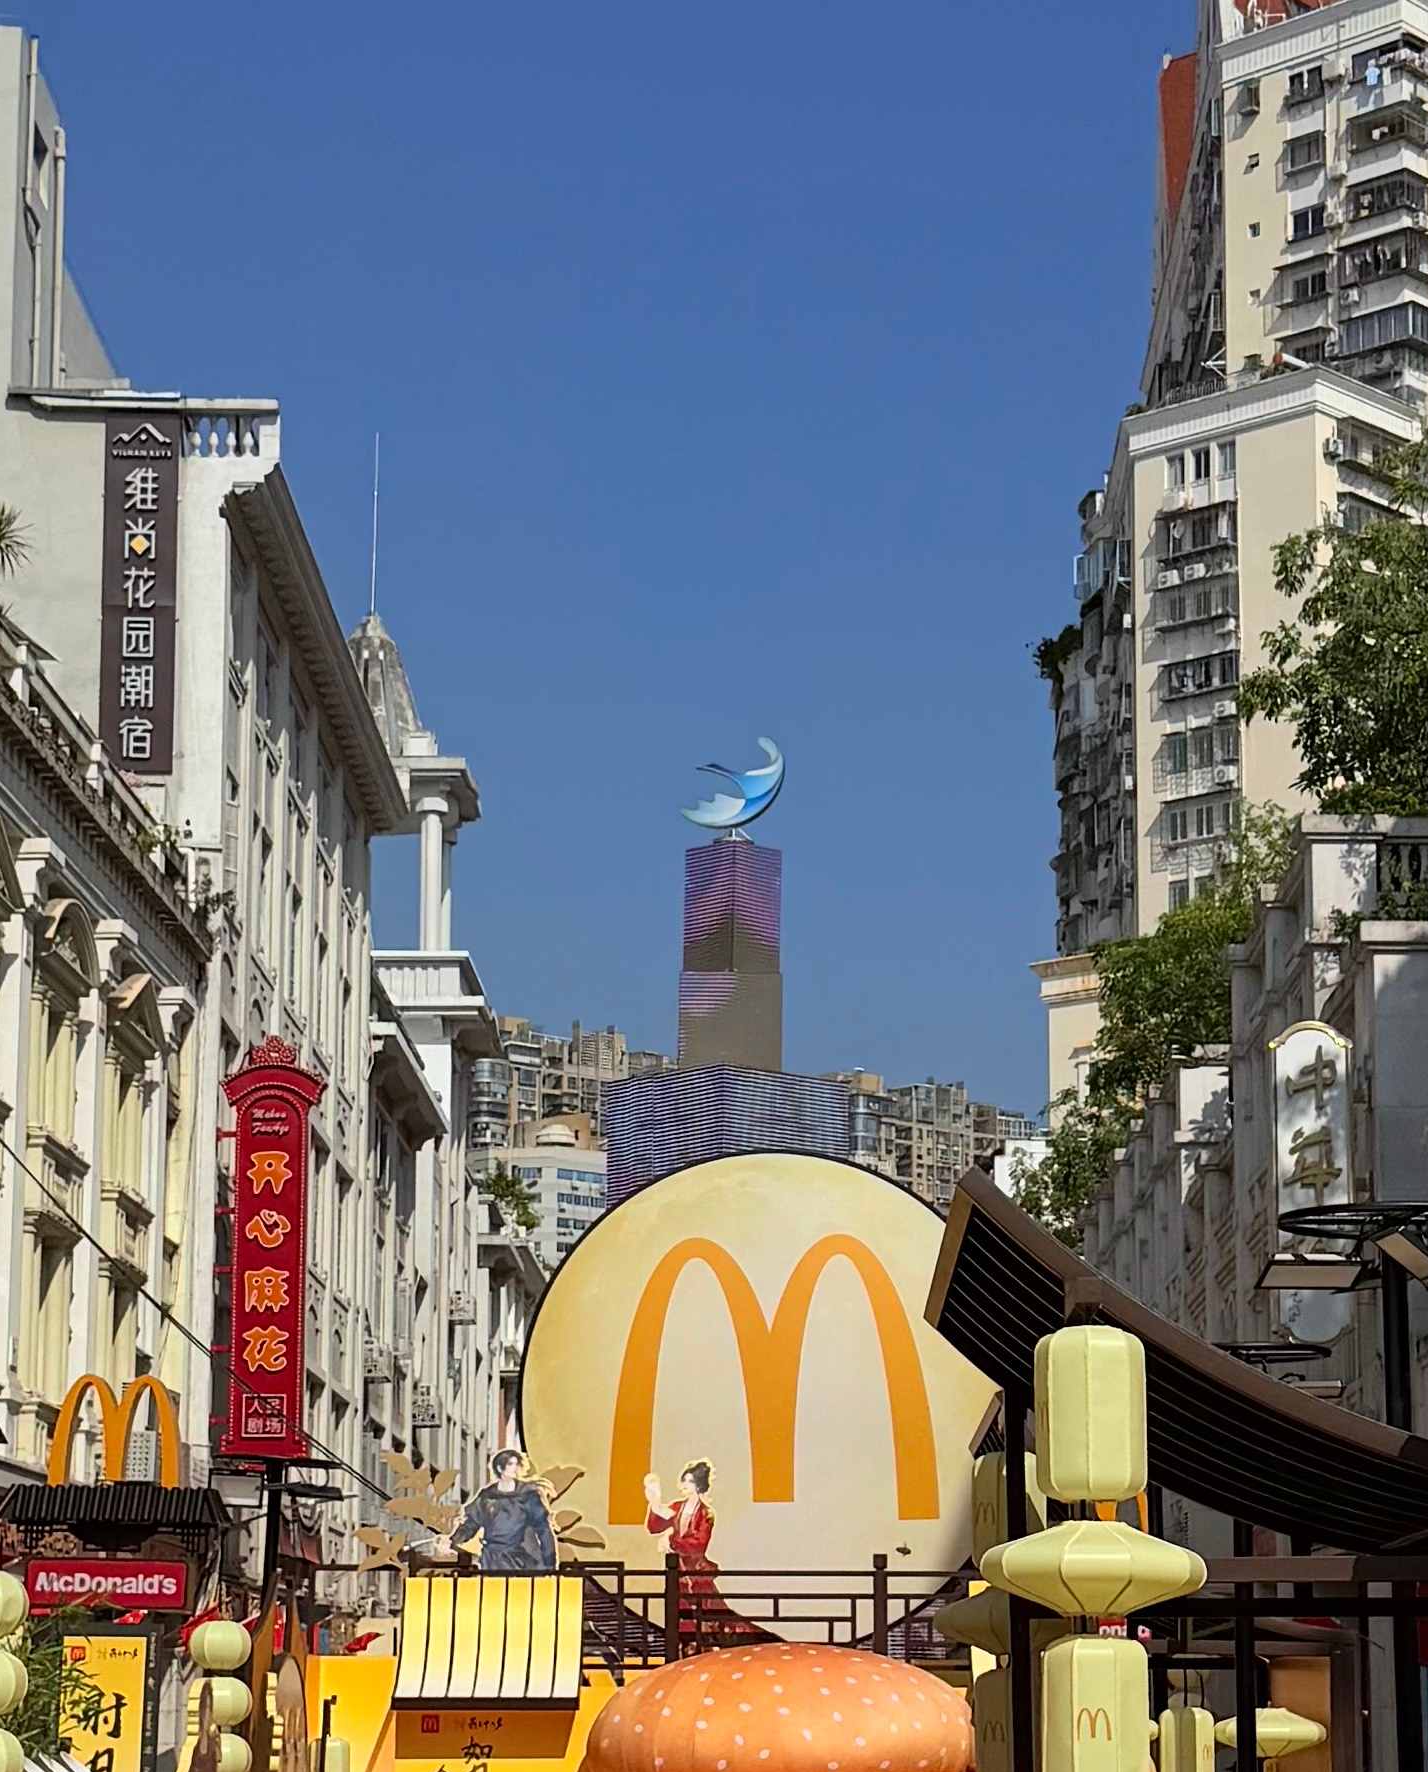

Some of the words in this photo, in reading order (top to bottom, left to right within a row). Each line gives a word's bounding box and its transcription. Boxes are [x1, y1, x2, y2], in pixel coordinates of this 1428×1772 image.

[119, 466, 160, 759] 维尚花园潮宿
[242, 1150, 292, 1373] 开心麻花
[35, 1571, 178, 1595] McDonald's
